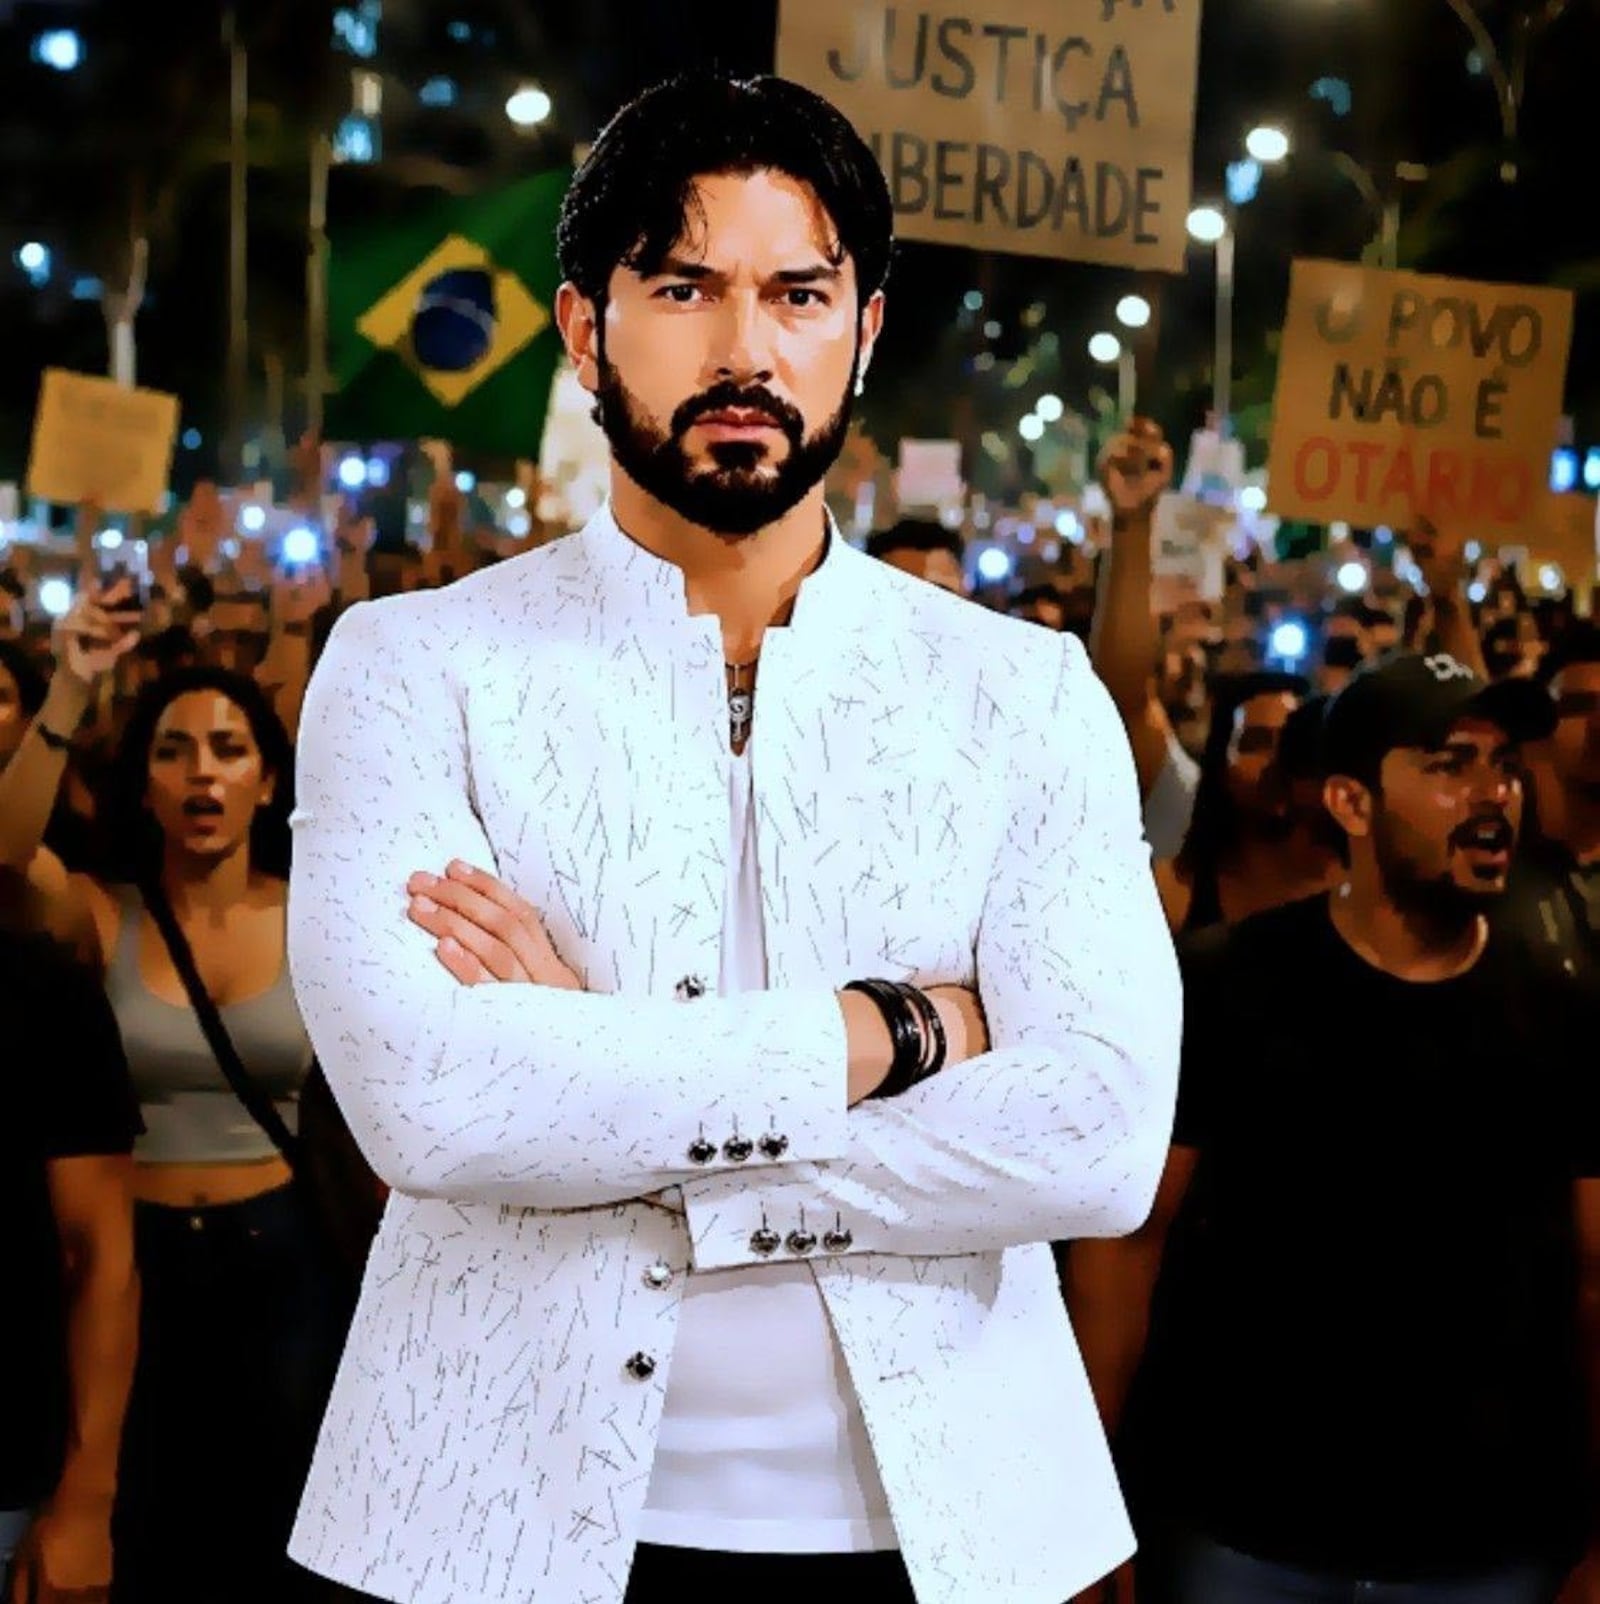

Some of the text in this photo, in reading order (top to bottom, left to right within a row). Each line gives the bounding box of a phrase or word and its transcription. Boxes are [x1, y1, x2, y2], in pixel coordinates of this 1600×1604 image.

[827, 7, 1139, 130] JUSTIÇA
[871, 131, 1163, 244] BERDADE
[1388, 288, 1543, 368] POVO
[1329, 355, 1449, 428] NÃO
